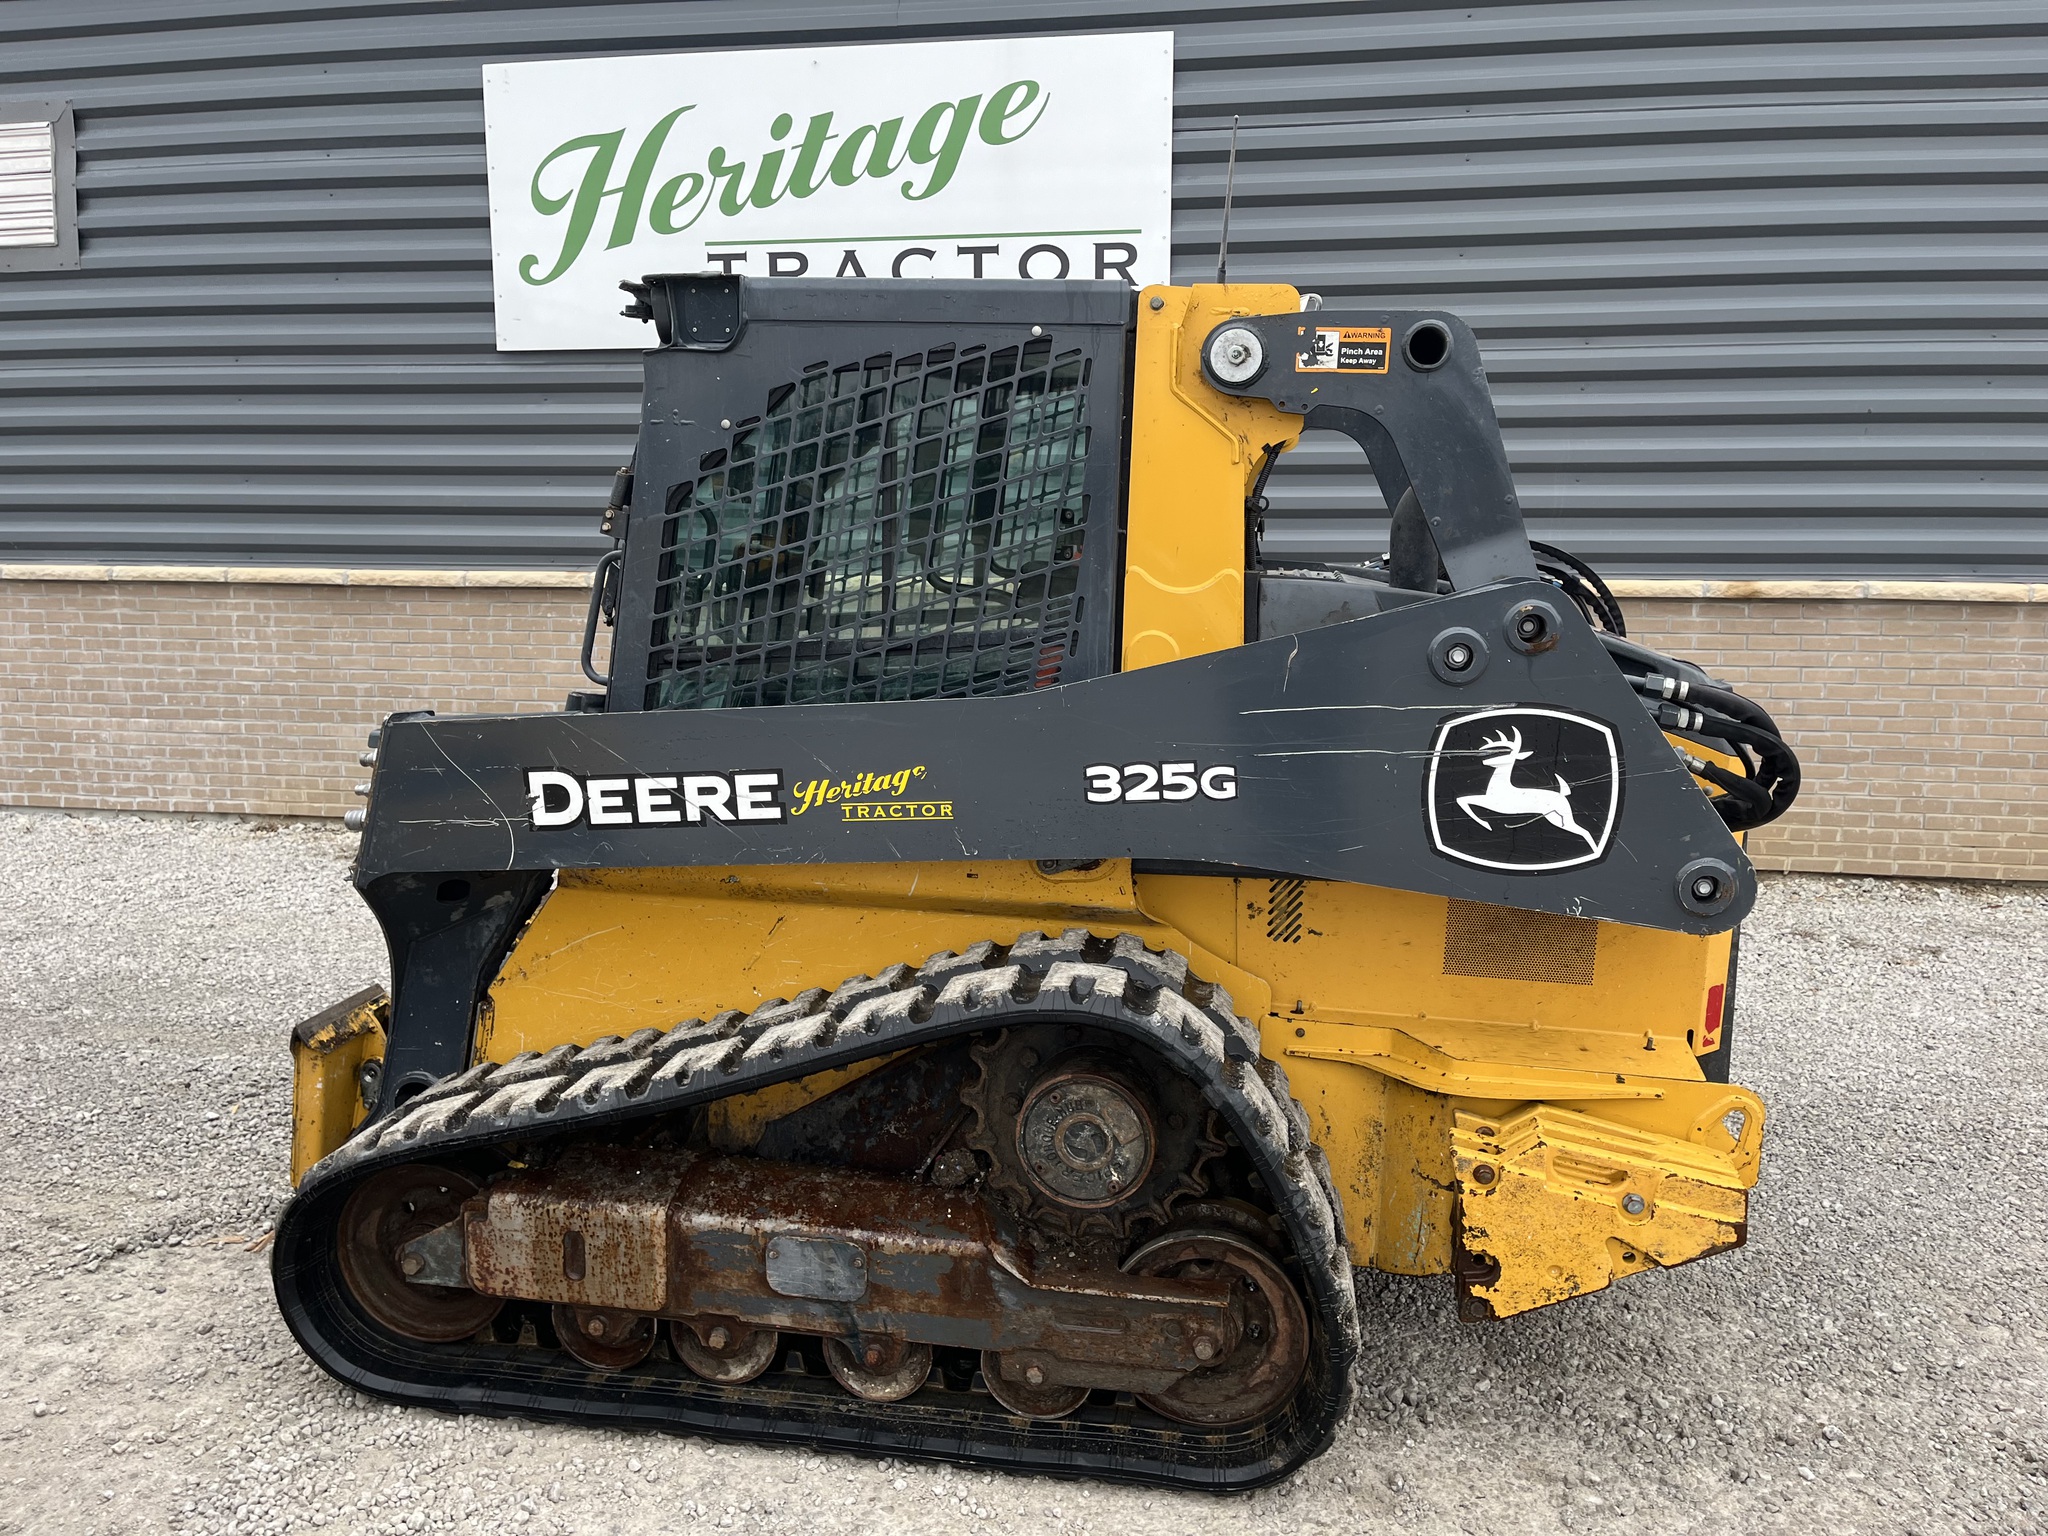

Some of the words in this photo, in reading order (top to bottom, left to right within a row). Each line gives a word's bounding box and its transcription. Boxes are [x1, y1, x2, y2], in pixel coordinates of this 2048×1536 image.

[519, 79, 1051, 287] Heritage
[706, 242, 1140, 286] TRACTOR
[1340, 356, 1358, 365] Keep
[1358, 357, 1377, 366] Away
[1341, 347, 1363, 355] Pinch
[1364, 347, 1383, 356] Area
[526, 770, 782, 826] DEERE
[1084, 762, 1238, 803] 325G
[841, 804, 953, 818] TRACTOR
